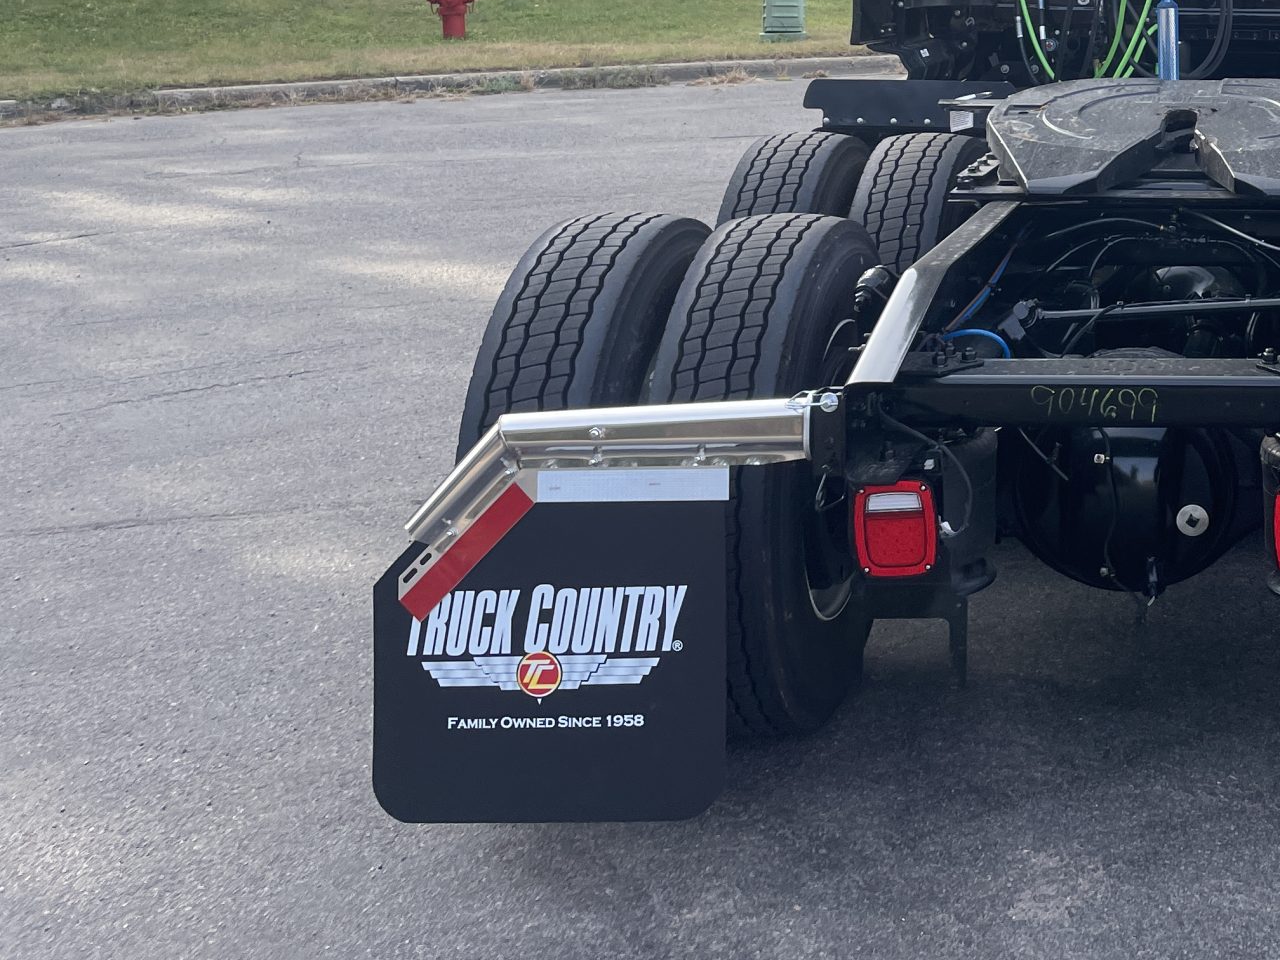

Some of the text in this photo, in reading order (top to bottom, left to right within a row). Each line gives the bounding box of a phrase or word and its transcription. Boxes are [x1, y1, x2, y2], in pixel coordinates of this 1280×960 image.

[1030, 385, 1159, 423] 904699
[447, 714, 645, 729] FAMILY OWNED SINCE 1958
